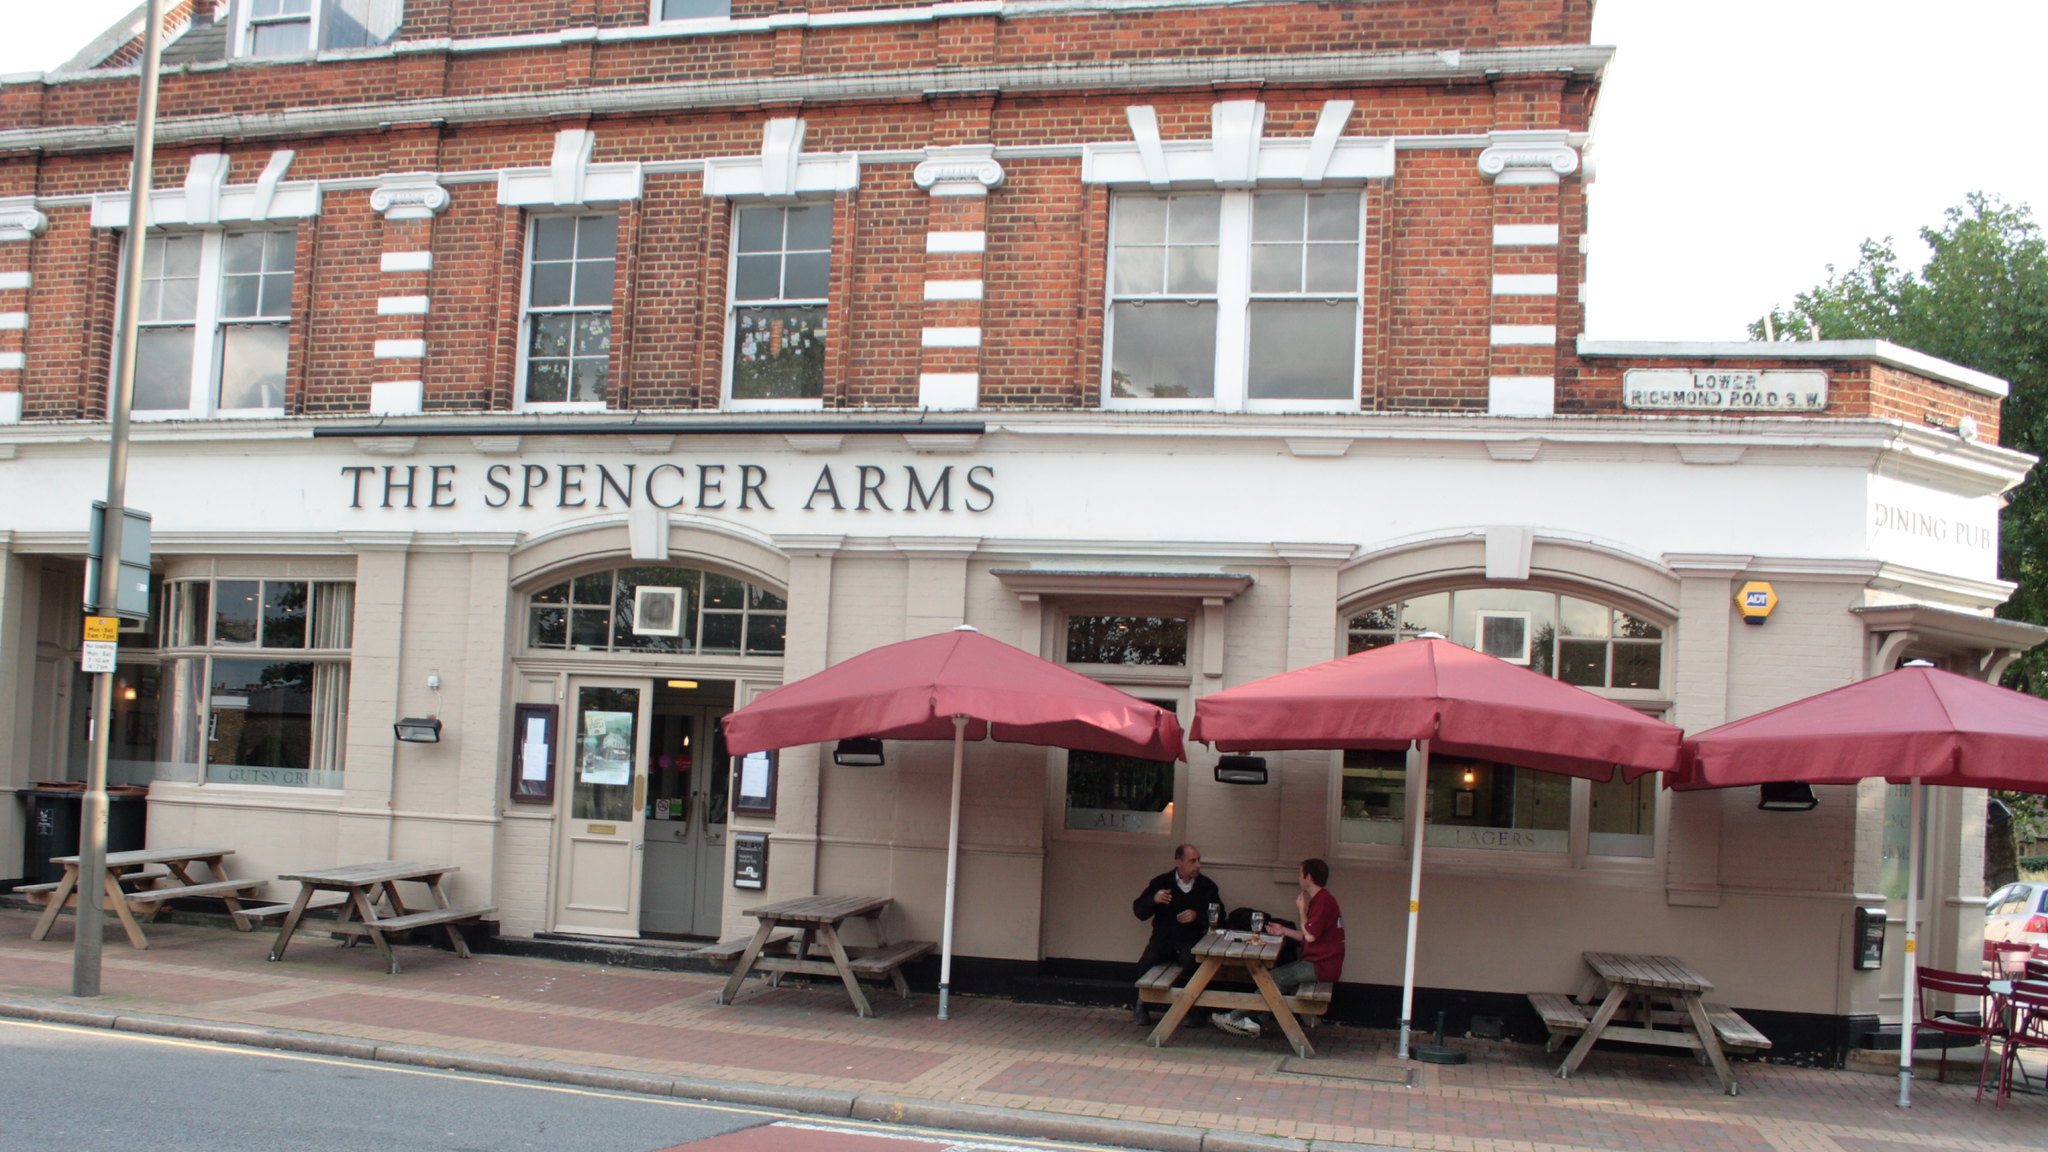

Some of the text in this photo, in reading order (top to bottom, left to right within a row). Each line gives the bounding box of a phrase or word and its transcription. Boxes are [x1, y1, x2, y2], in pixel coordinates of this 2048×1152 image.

[1693, 374, 1756, 390] LOWER
[1632, 390, 1722, 406] RICHMOND
[1729, 391, 1778, 407] ROAD
[341, 463, 996, 512] THE SPENCER ARMS
[1875, 503, 1991, 550] DINING PUB
[1747, 593, 1768, 605] ADT
[228, 768, 279, 783] GUTSY
[1455, 829, 1535, 847] LAGERS
